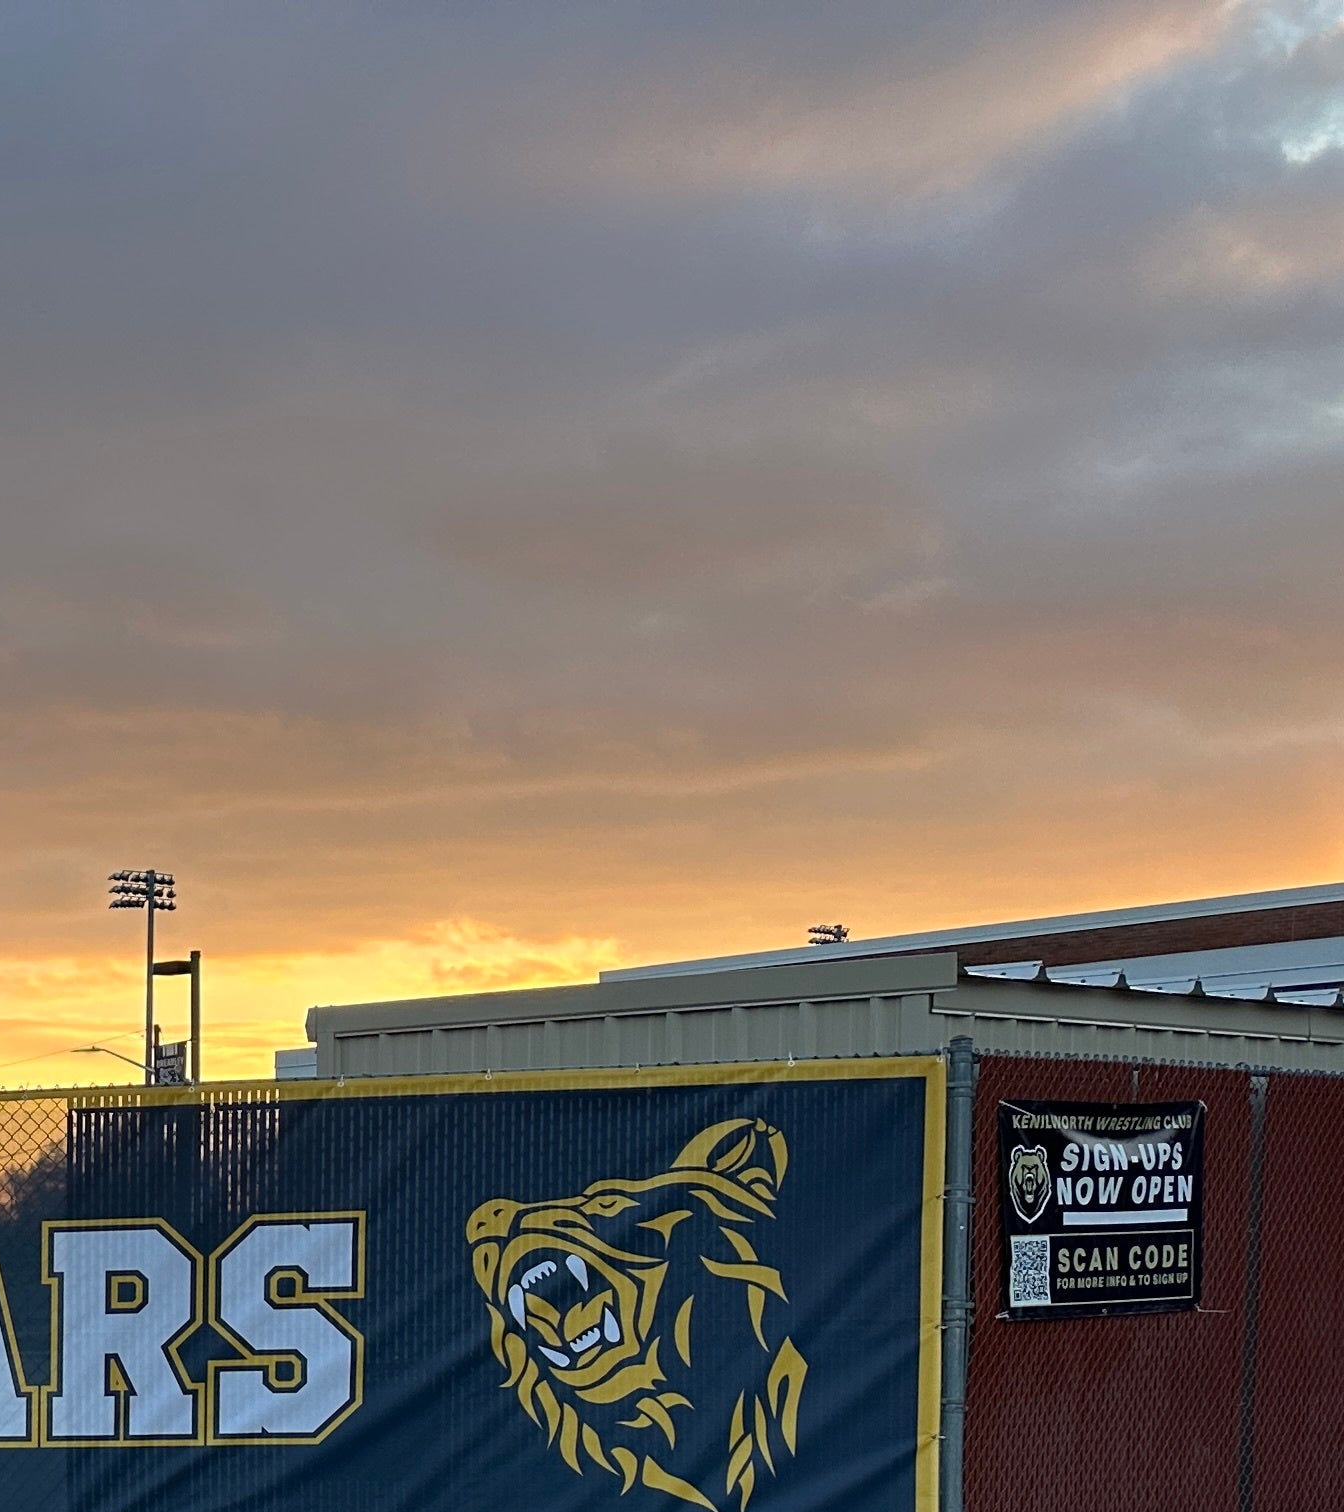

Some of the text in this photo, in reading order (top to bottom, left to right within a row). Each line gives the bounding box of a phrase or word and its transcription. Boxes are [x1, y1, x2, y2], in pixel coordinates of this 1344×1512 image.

[1012, 1114, 1192, 1131] KENILWORTH WRESTLING CLUB
[1060, 1142, 1183, 1171] SIGN-UPS
[1056, 1175, 1193, 1205] NOW OPEN
[1057, 1244, 1188, 1273] SCAN CODE
[1056, 1271, 1188, 1290] FOR MORE INFO & TO SIGN UP
